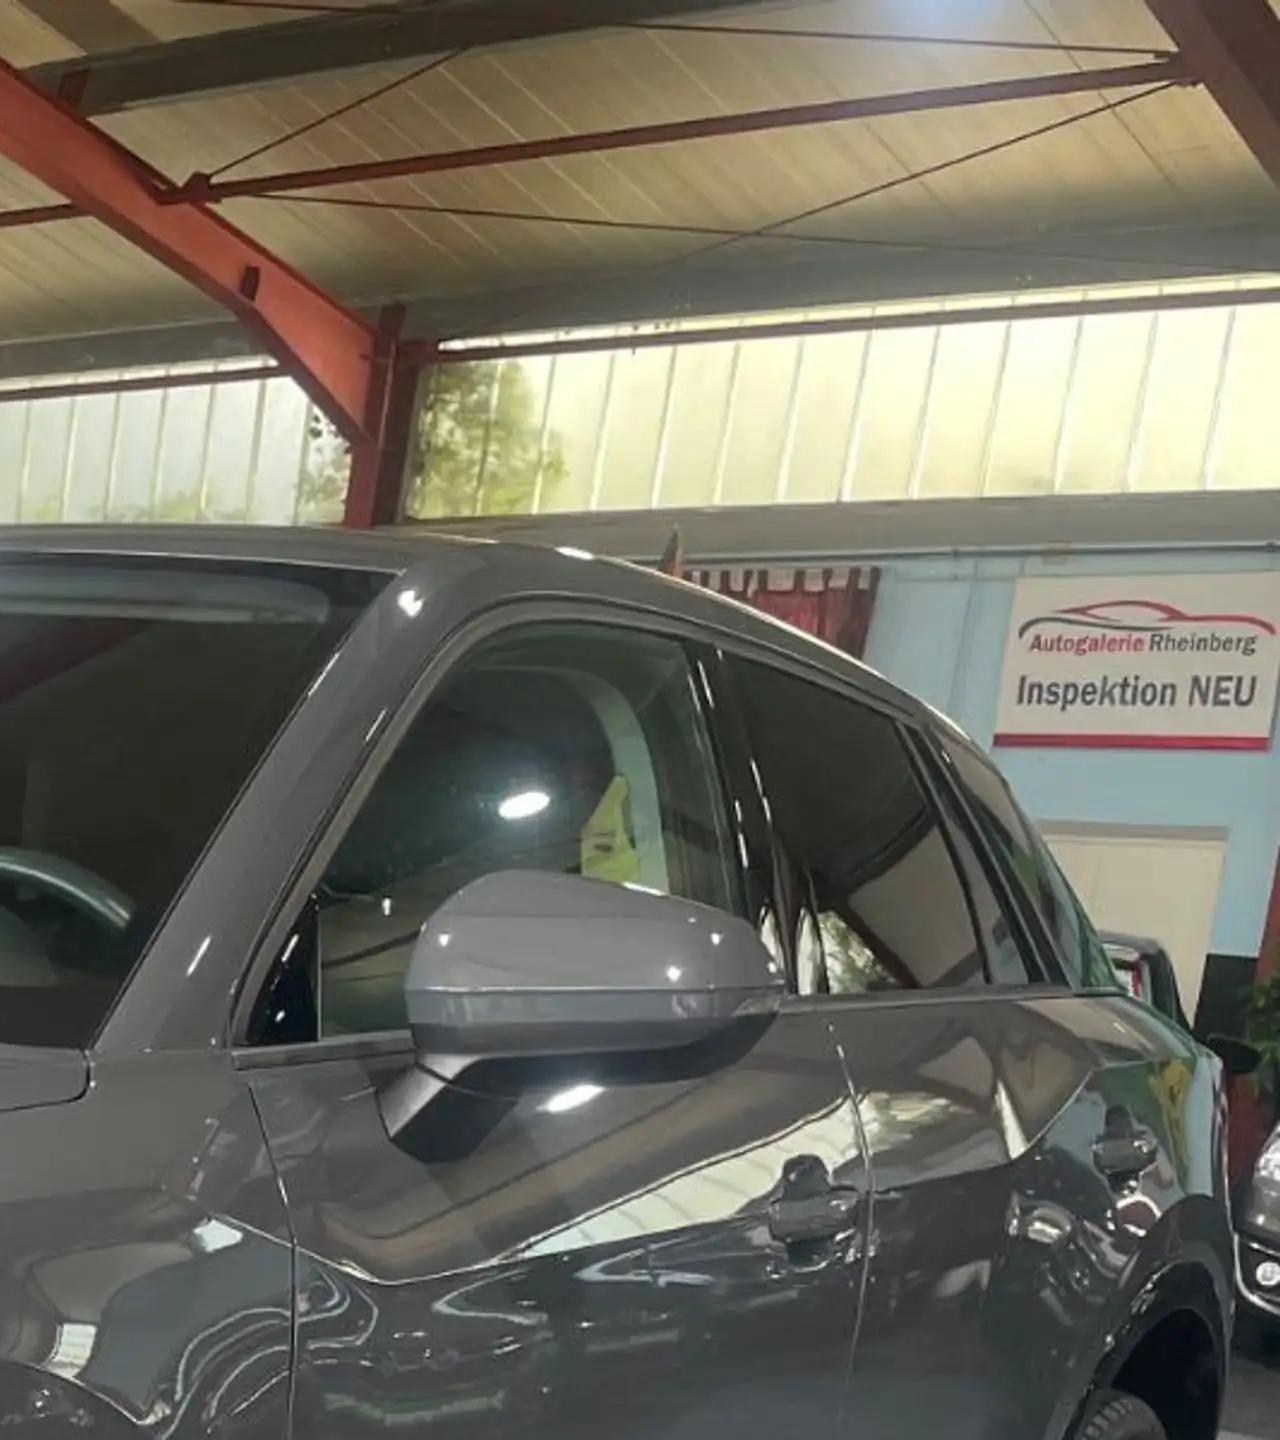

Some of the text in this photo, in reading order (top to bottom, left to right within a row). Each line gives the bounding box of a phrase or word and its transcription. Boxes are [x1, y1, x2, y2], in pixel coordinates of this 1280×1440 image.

[1029, 633, 1258, 656] Autogalerie Rheinberg
[1016, 674, 1259, 711] Inspektion NEU
